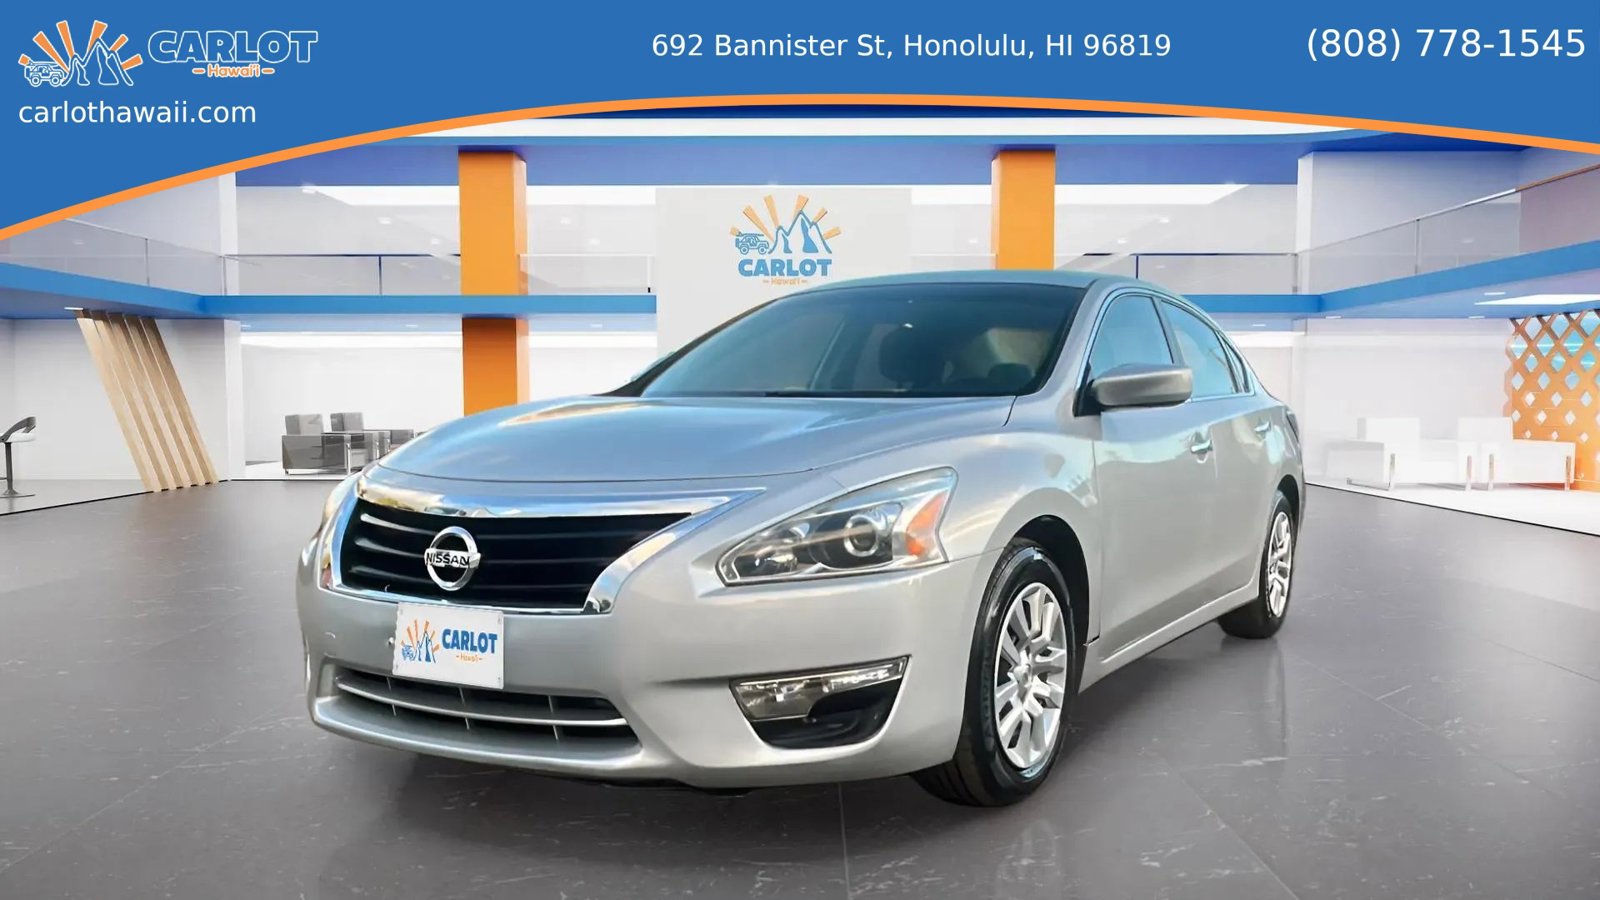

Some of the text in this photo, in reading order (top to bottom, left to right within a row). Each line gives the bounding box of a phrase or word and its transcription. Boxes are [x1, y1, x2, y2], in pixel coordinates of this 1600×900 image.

[738, 258, 832, 277] CARLOT
[425, 552, 470, 567] NISSAN
[441, 628, 498, 654] CARLOT
